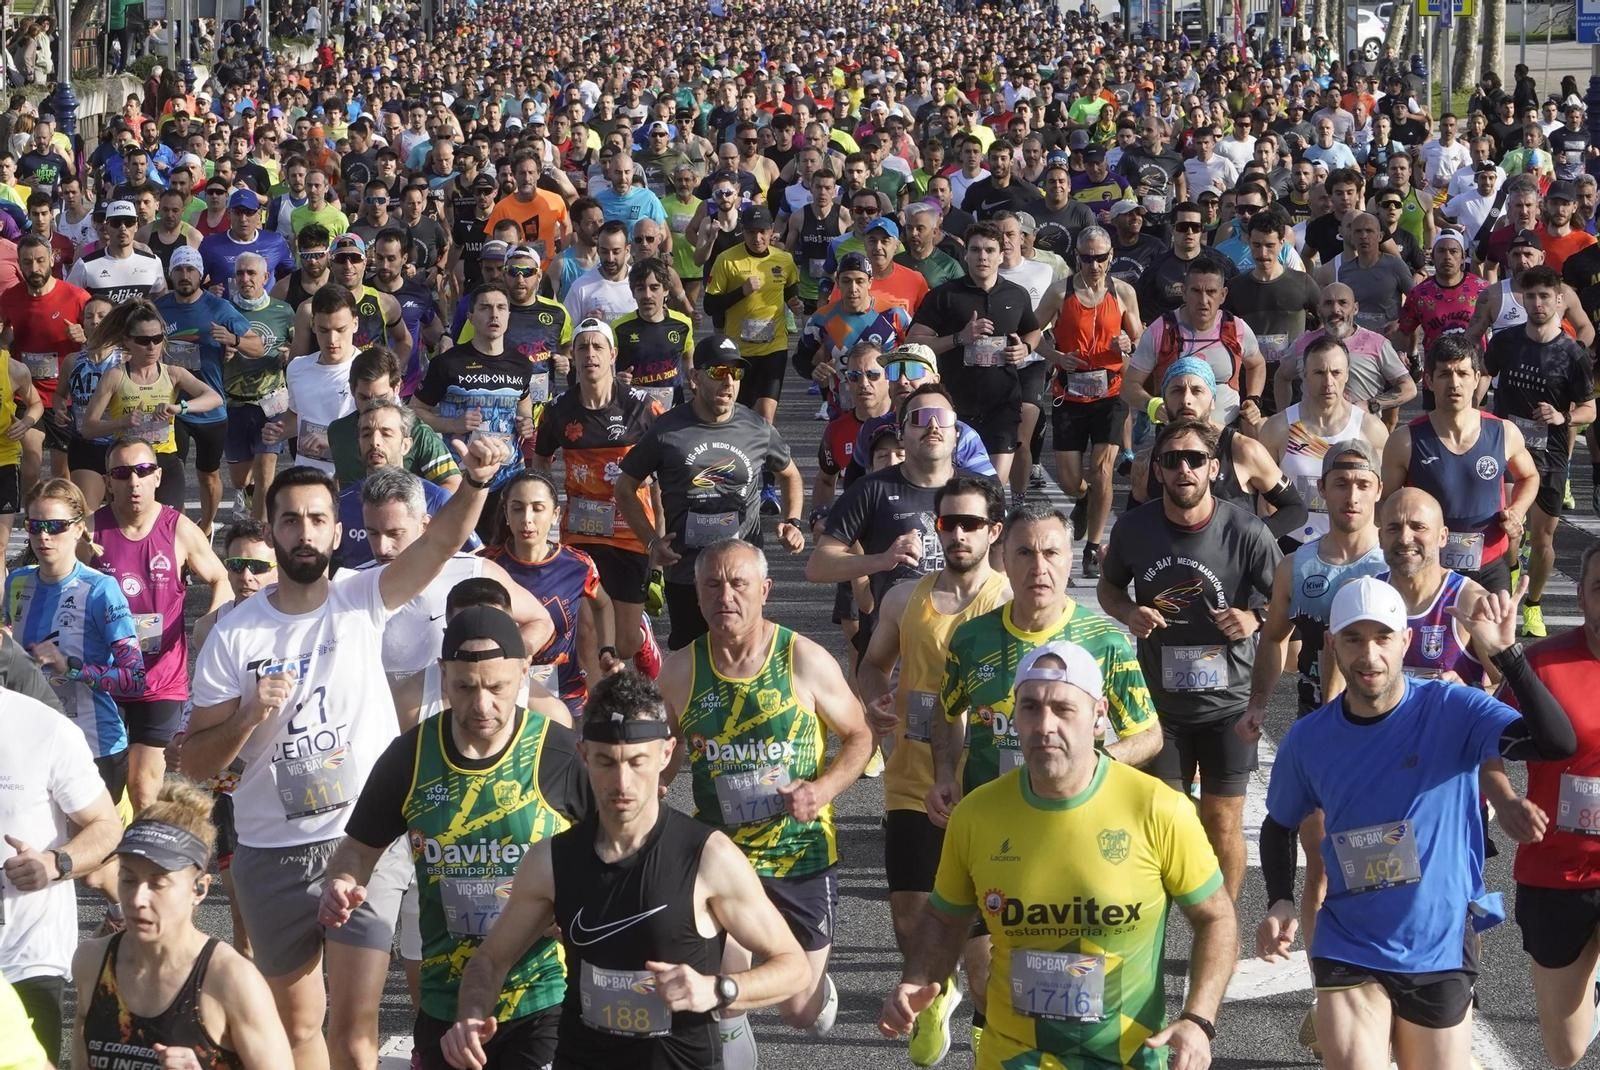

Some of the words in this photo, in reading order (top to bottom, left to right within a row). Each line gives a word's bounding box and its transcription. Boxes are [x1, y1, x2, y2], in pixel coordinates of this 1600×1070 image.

[113, 204, 131, 212] HOKA
[458, 373, 505, 384] POSEIDON
[684, 442, 709, 467] VIG-BAY
[712, 442, 730, 450] MEDIO
[579, 519, 604, 533] 365
[1143, 556, 1172, 582] VIG-BAY
[1177, 557, 1199, 569] MEDIO
[1197, 564, 1223, 593] MARATÓN
[1306, 580, 1324, 590] Kiwi
[1175, 670, 1218, 688] 2004
[705, 736, 796, 763] Davitex
[303, 780, 346, 810] 411
[426, 793, 450, 801] SPORT
[736, 794, 784, 822] 1719
[426, 866, 508, 876] estamparia,
[1364, 857, 1405, 884] 492
[1001, 896, 1142, 927] Davitex
[1004, 926, 1108, 938] estamparia,
[1113, 924, 1139, 935] s.a.
[1026, 986, 1090, 1015] 1716
[601, 1004, 651, 1031] 188
[88, 1040, 103, 1050] OS
[90, 1055, 110, 1069] DO
